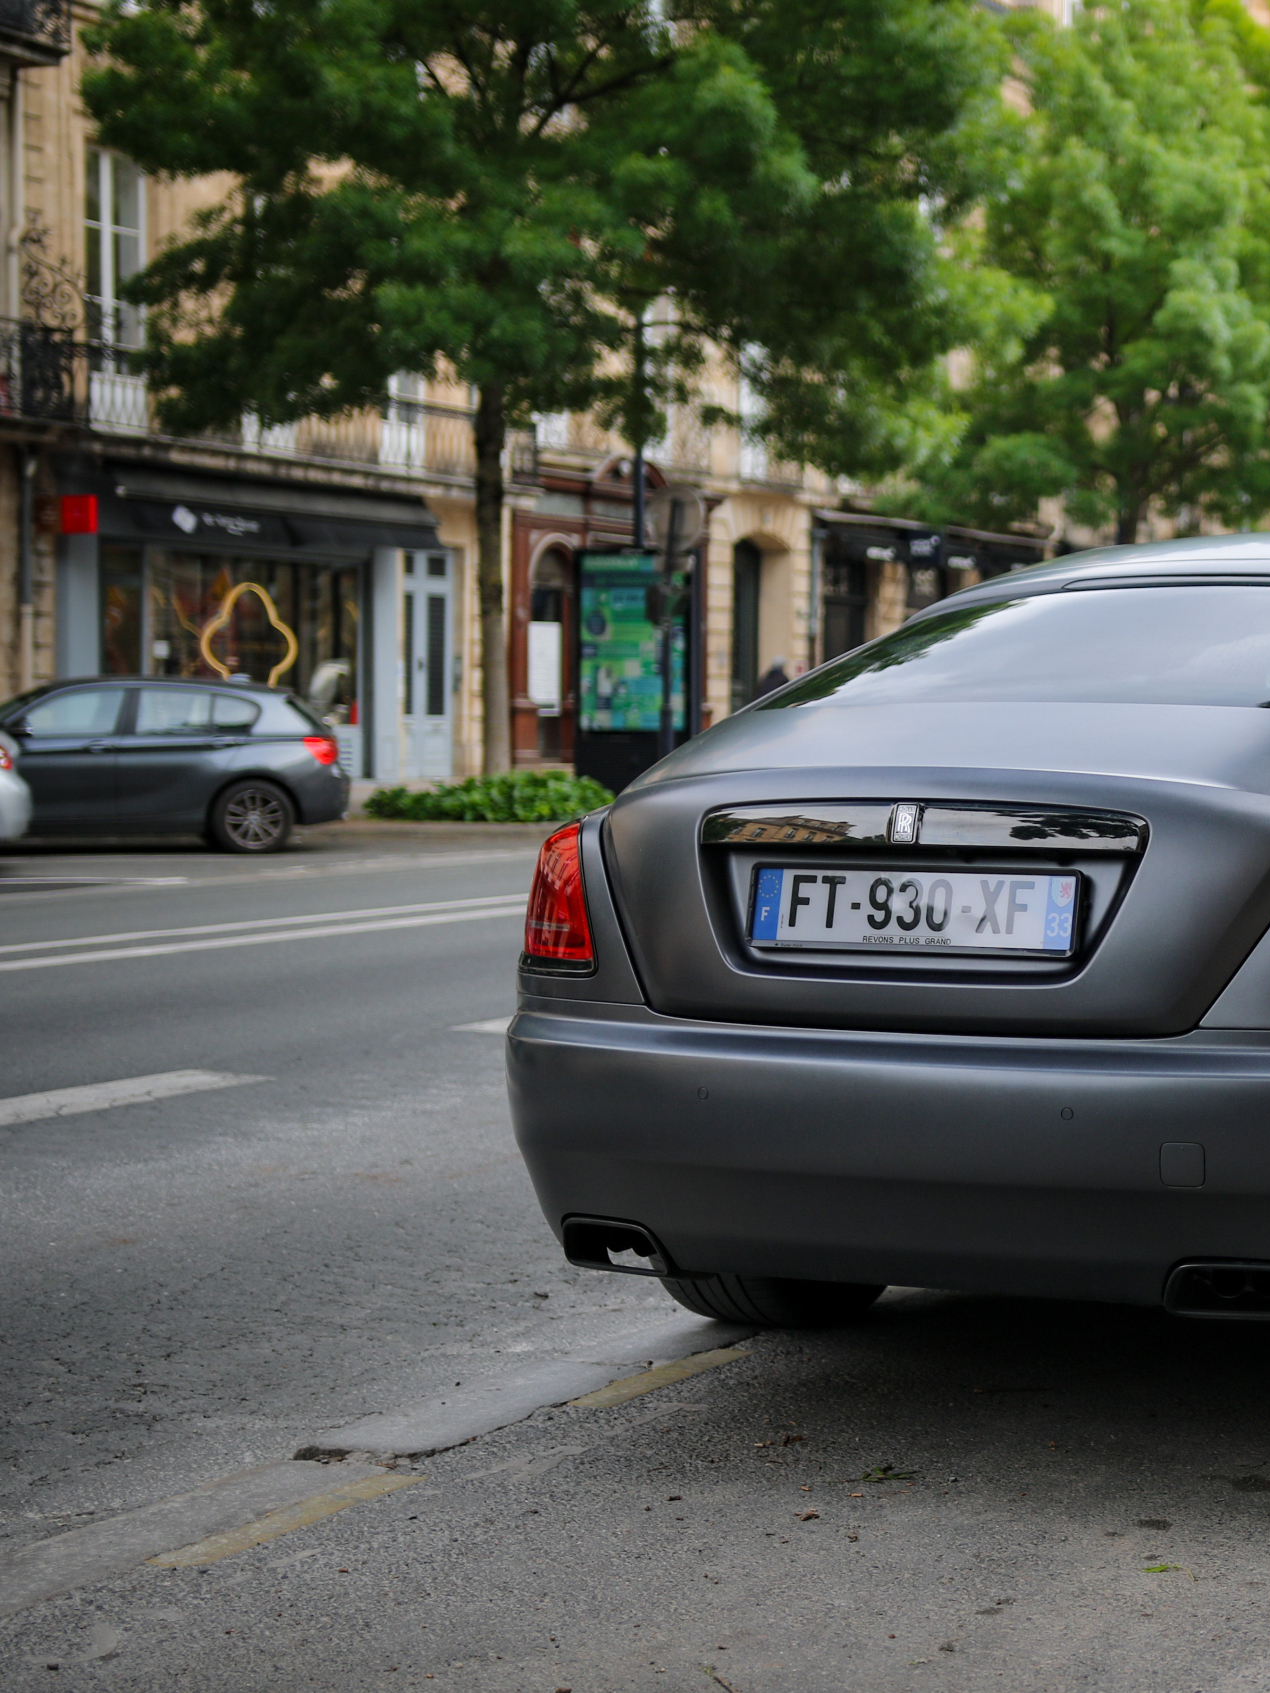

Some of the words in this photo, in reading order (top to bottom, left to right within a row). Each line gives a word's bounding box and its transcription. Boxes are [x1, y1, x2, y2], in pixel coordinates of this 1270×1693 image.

[760, 906, 771, 922] F
[788, 874, 1036, 935] FT-930-XF
[1046, 912, 1072, 938] 33
[862, 935, 895, 944] REVONS
[898, 936, 921, 945] PLUS
[924, 937, 952, 946] GRAND
